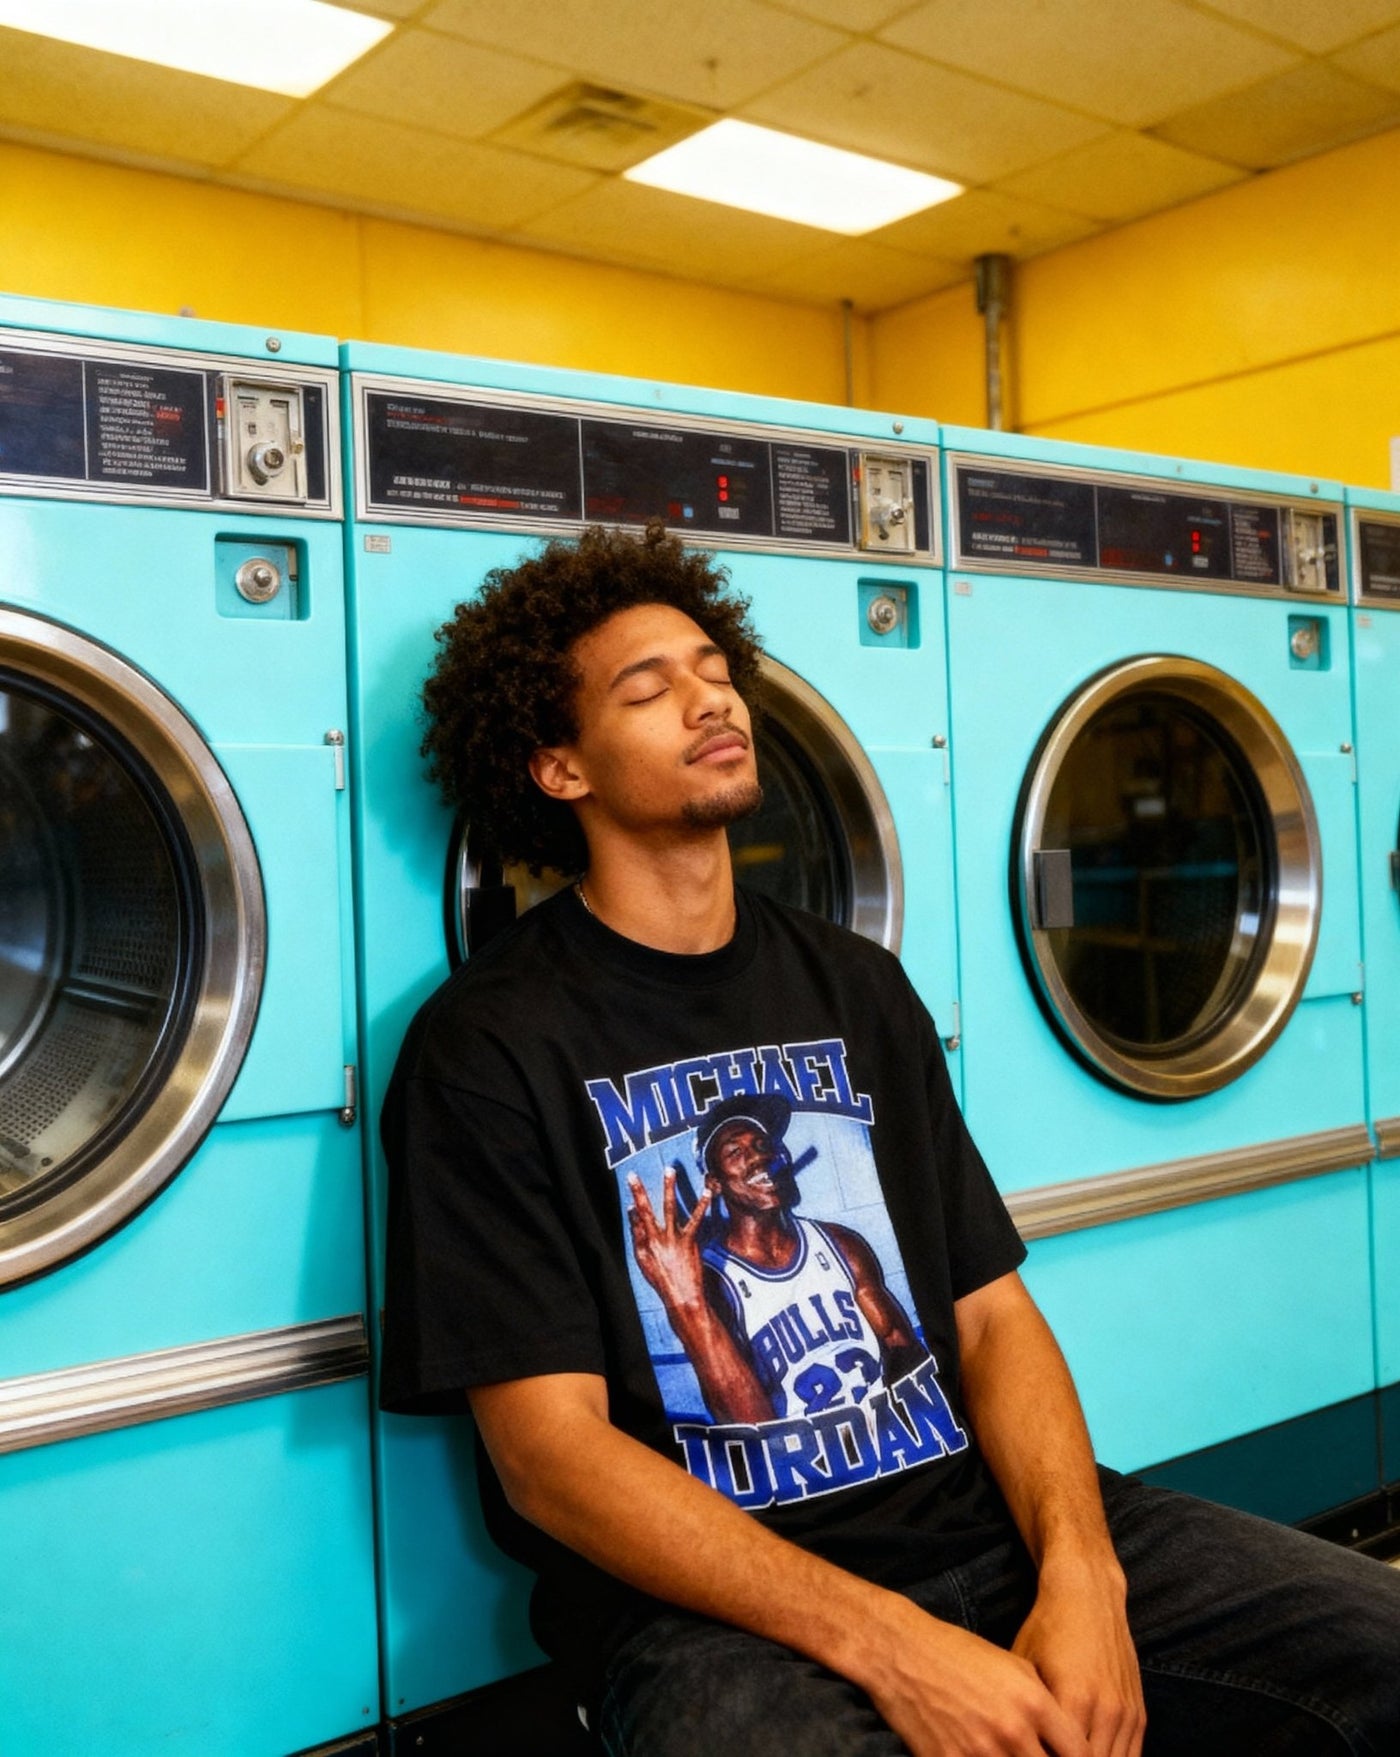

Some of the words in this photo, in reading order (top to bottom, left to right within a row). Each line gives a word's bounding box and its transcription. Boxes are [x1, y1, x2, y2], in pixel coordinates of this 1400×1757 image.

[585, 1038, 875, 1169] MICHAEL
[750, 1290, 864, 1381] BULLS
[673, 1355, 968, 1511] JORDAN
